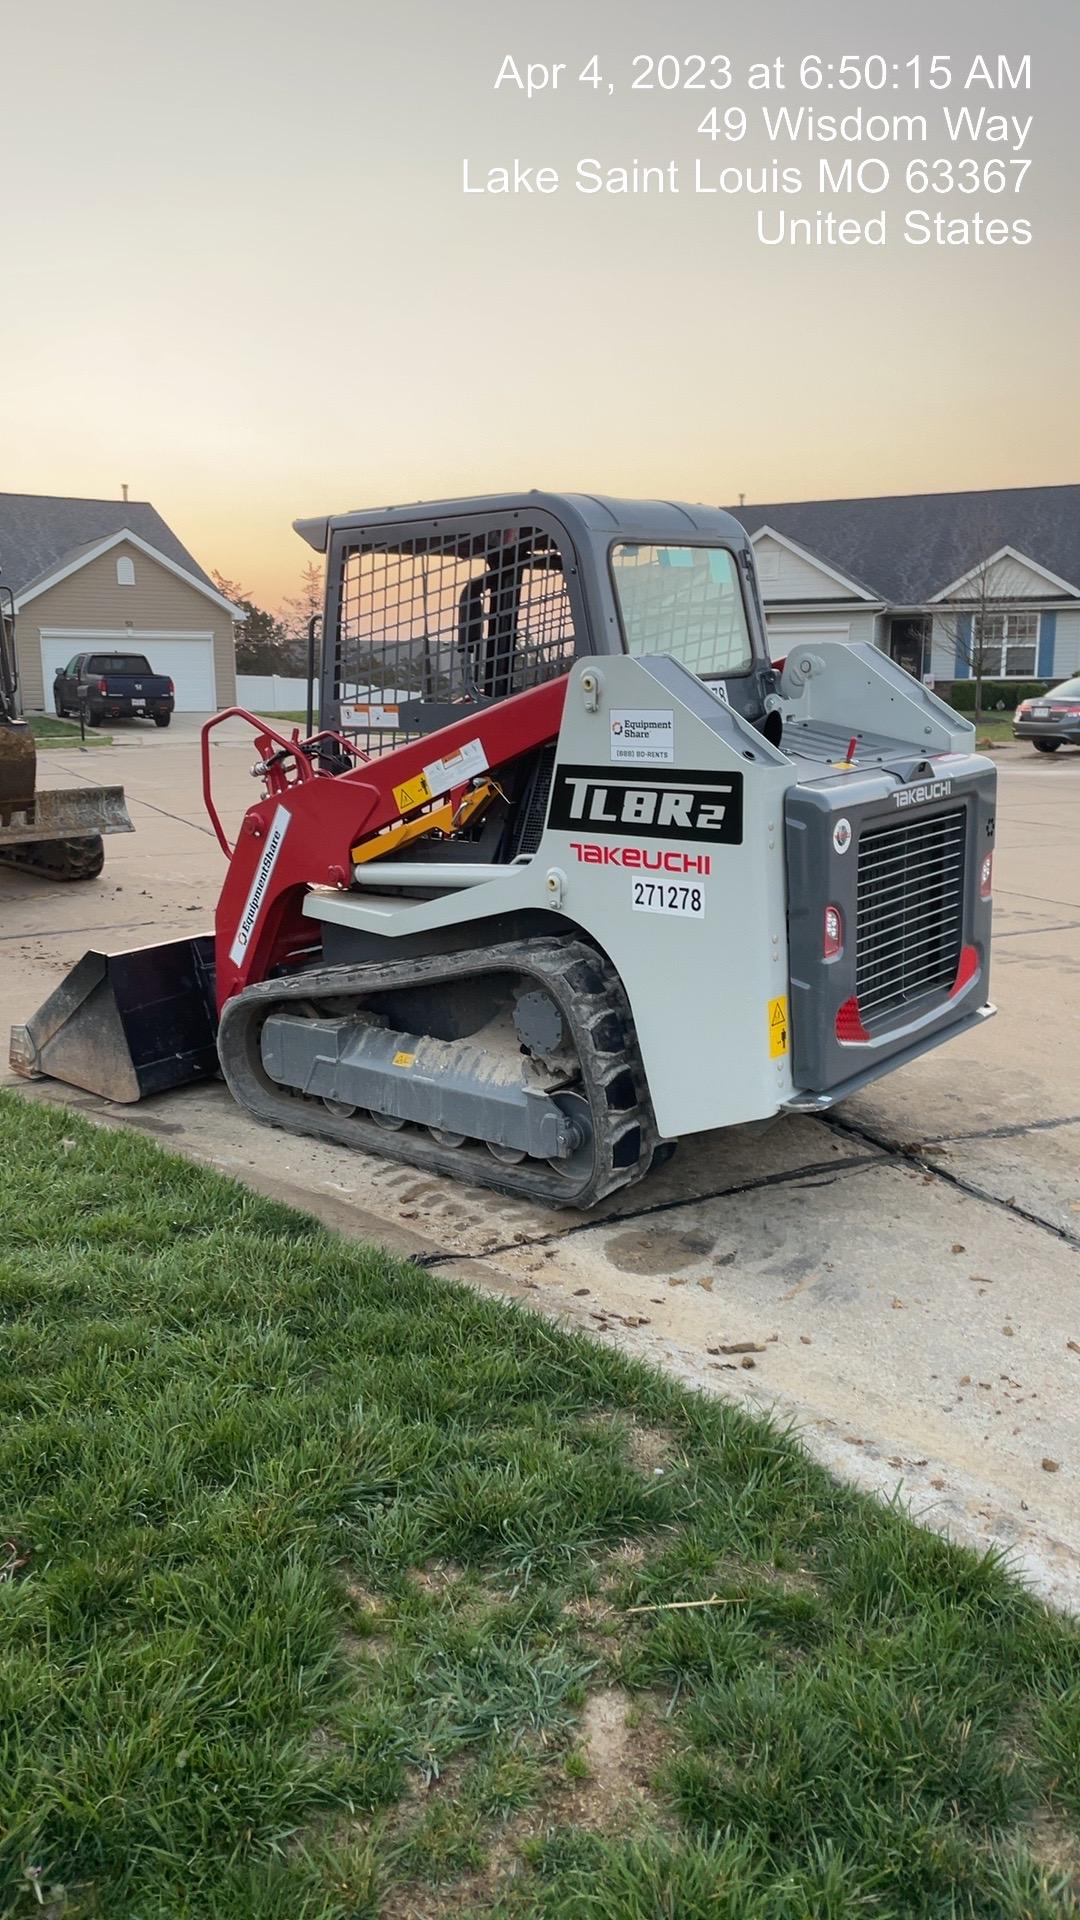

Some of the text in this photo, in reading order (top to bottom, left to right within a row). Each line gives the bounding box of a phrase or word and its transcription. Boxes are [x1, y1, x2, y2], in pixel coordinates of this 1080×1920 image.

[624, 719, 672, 730] Equipment
[624, 729, 650, 739] Share
[565, 777, 733, 830] TL8R2
[892, 780, 951, 808] TAKEUCHI
[569, 842, 711, 876] TAKEUCHI
[241, 830, 281, 934] EquipmentShare
[633, 882, 703, 912] 271278
